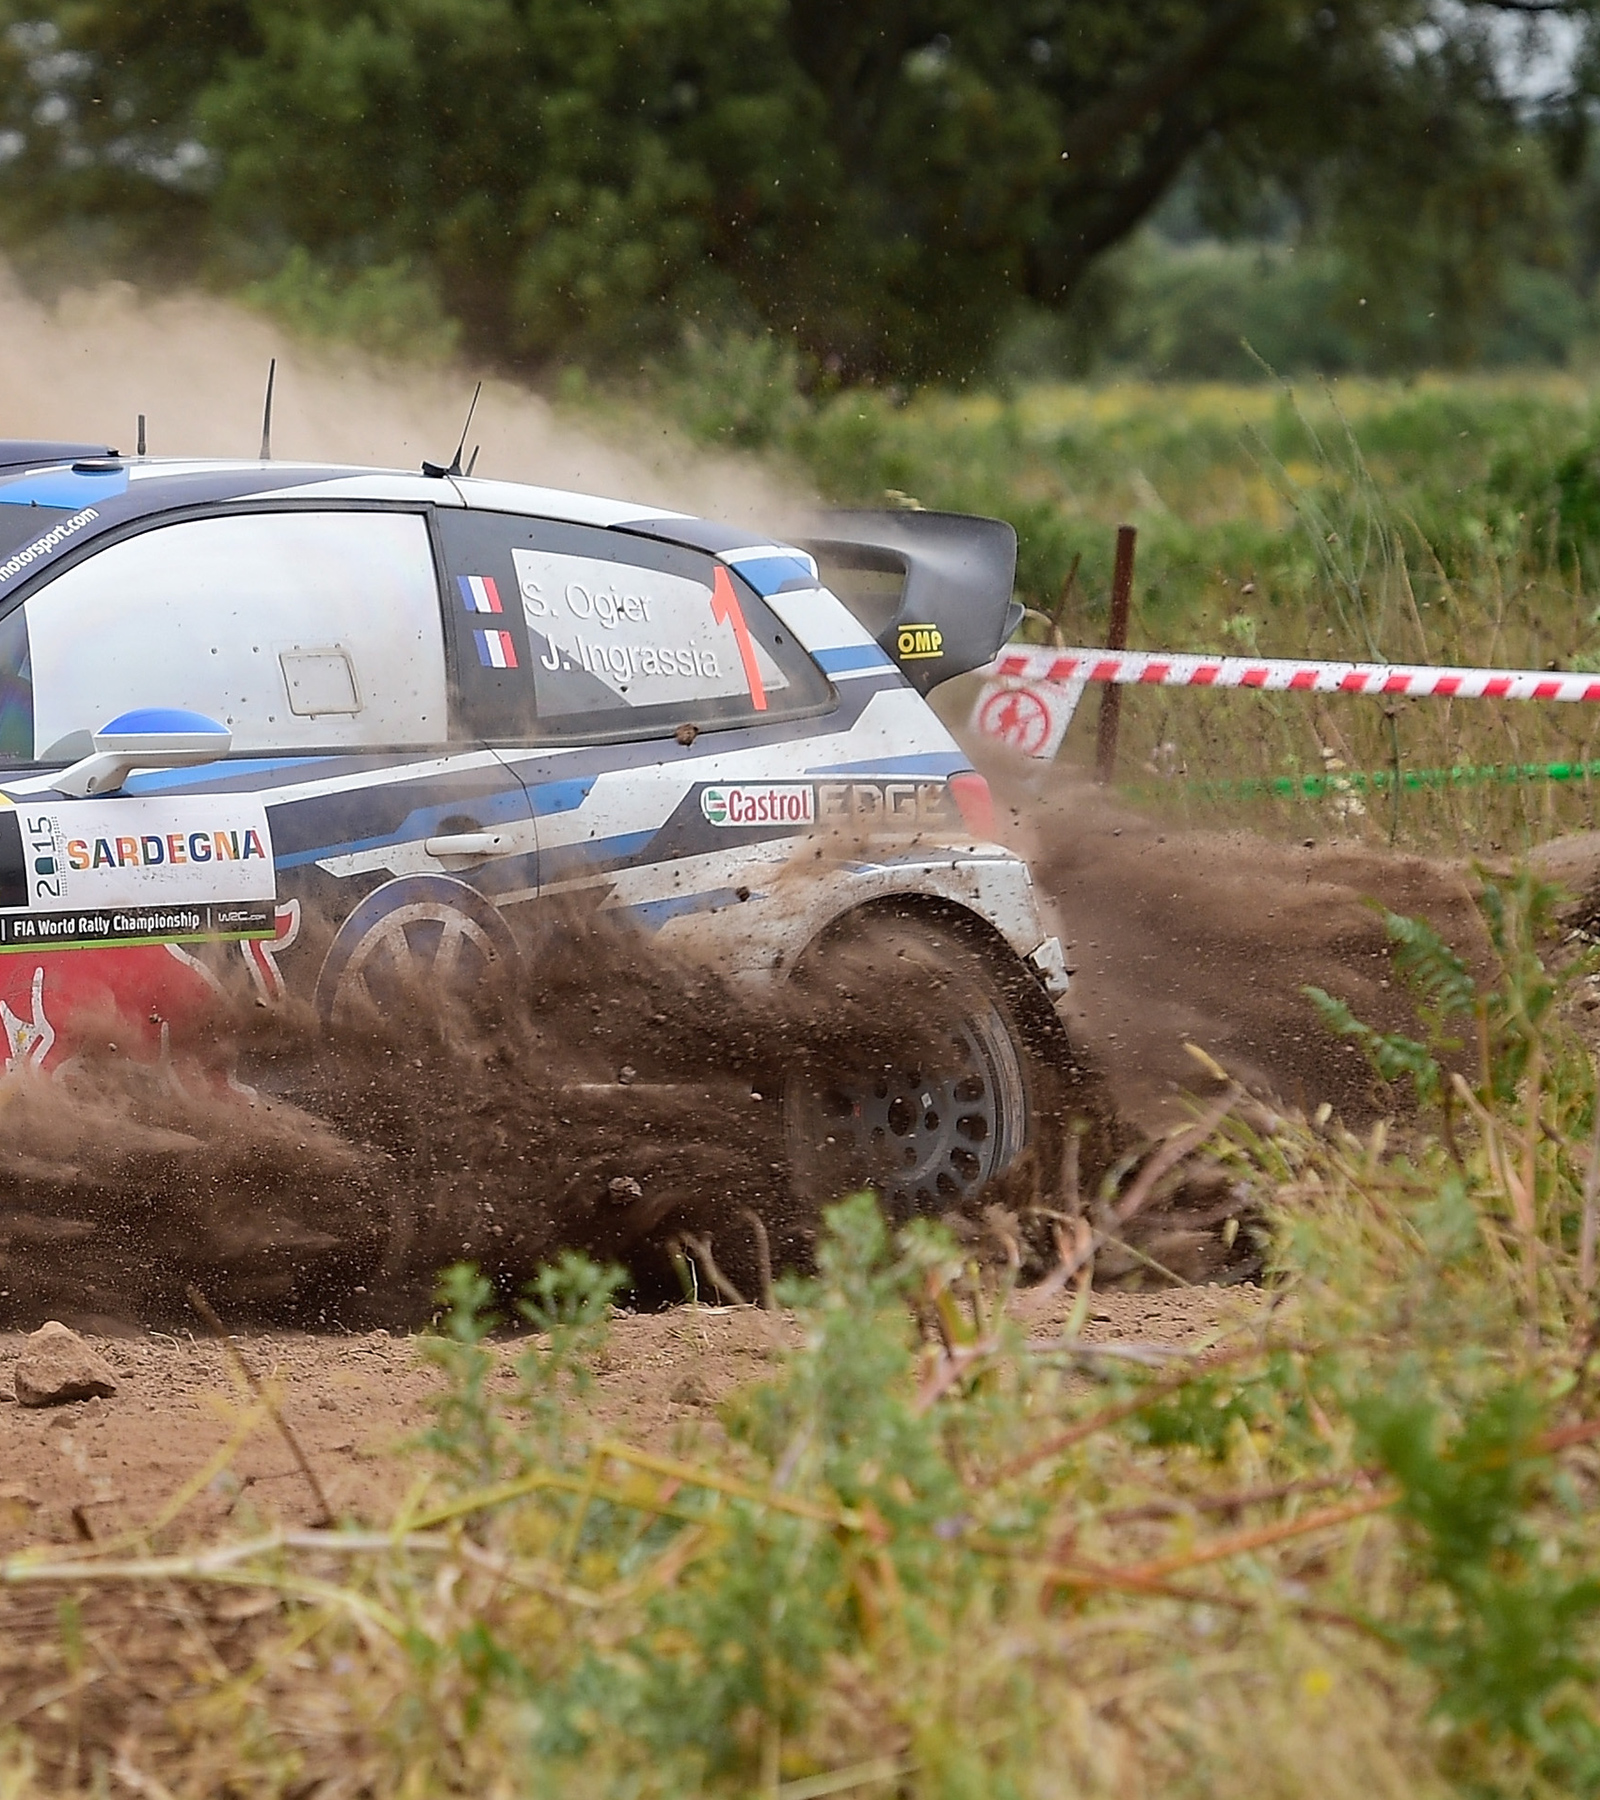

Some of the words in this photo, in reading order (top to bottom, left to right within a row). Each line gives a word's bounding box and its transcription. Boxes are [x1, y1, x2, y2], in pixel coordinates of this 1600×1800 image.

[521, 580, 559, 619] S.
[564, 583, 653, 630] Ogier
[540, 634, 571, 671] J.
[575, 634, 722, 684] Ingrassia
[710, 566, 767, 711] 1
[898, 630, 943, 653] OMP
[729, 789, 811, 822] Castrol
[27, 816, 60, 898] 2015
[67, 830, 266, 871] SARDEGNA
[13, 918, 36, 937] FIA
[37, 915, 76, 935] World
[78, 911, 110, 936] Rally
[112, 908, 200, 935] Championship
